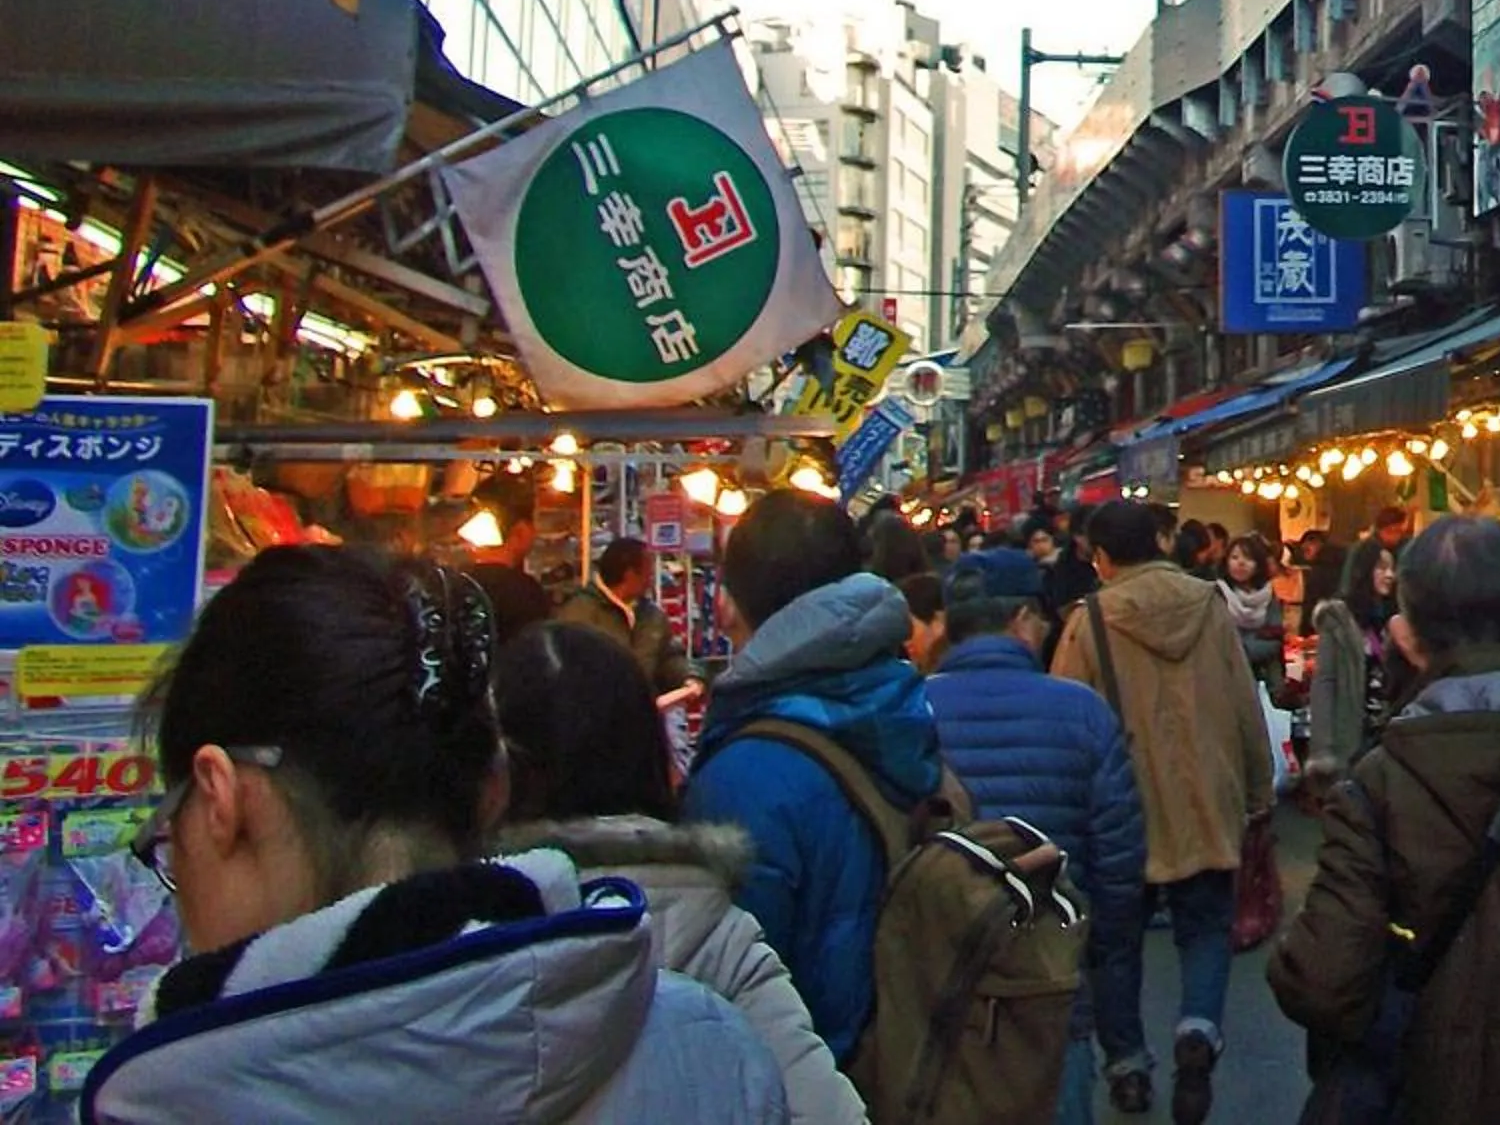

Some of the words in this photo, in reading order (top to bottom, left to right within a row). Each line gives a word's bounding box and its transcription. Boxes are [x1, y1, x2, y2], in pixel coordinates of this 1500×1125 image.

[1298, 154, 1416, 187] 三幸商店
[571, 132, 700, 364] 三幸商店
[2, 537, 109, 557] SPONGE
[2, 754, 156, 798] 540
